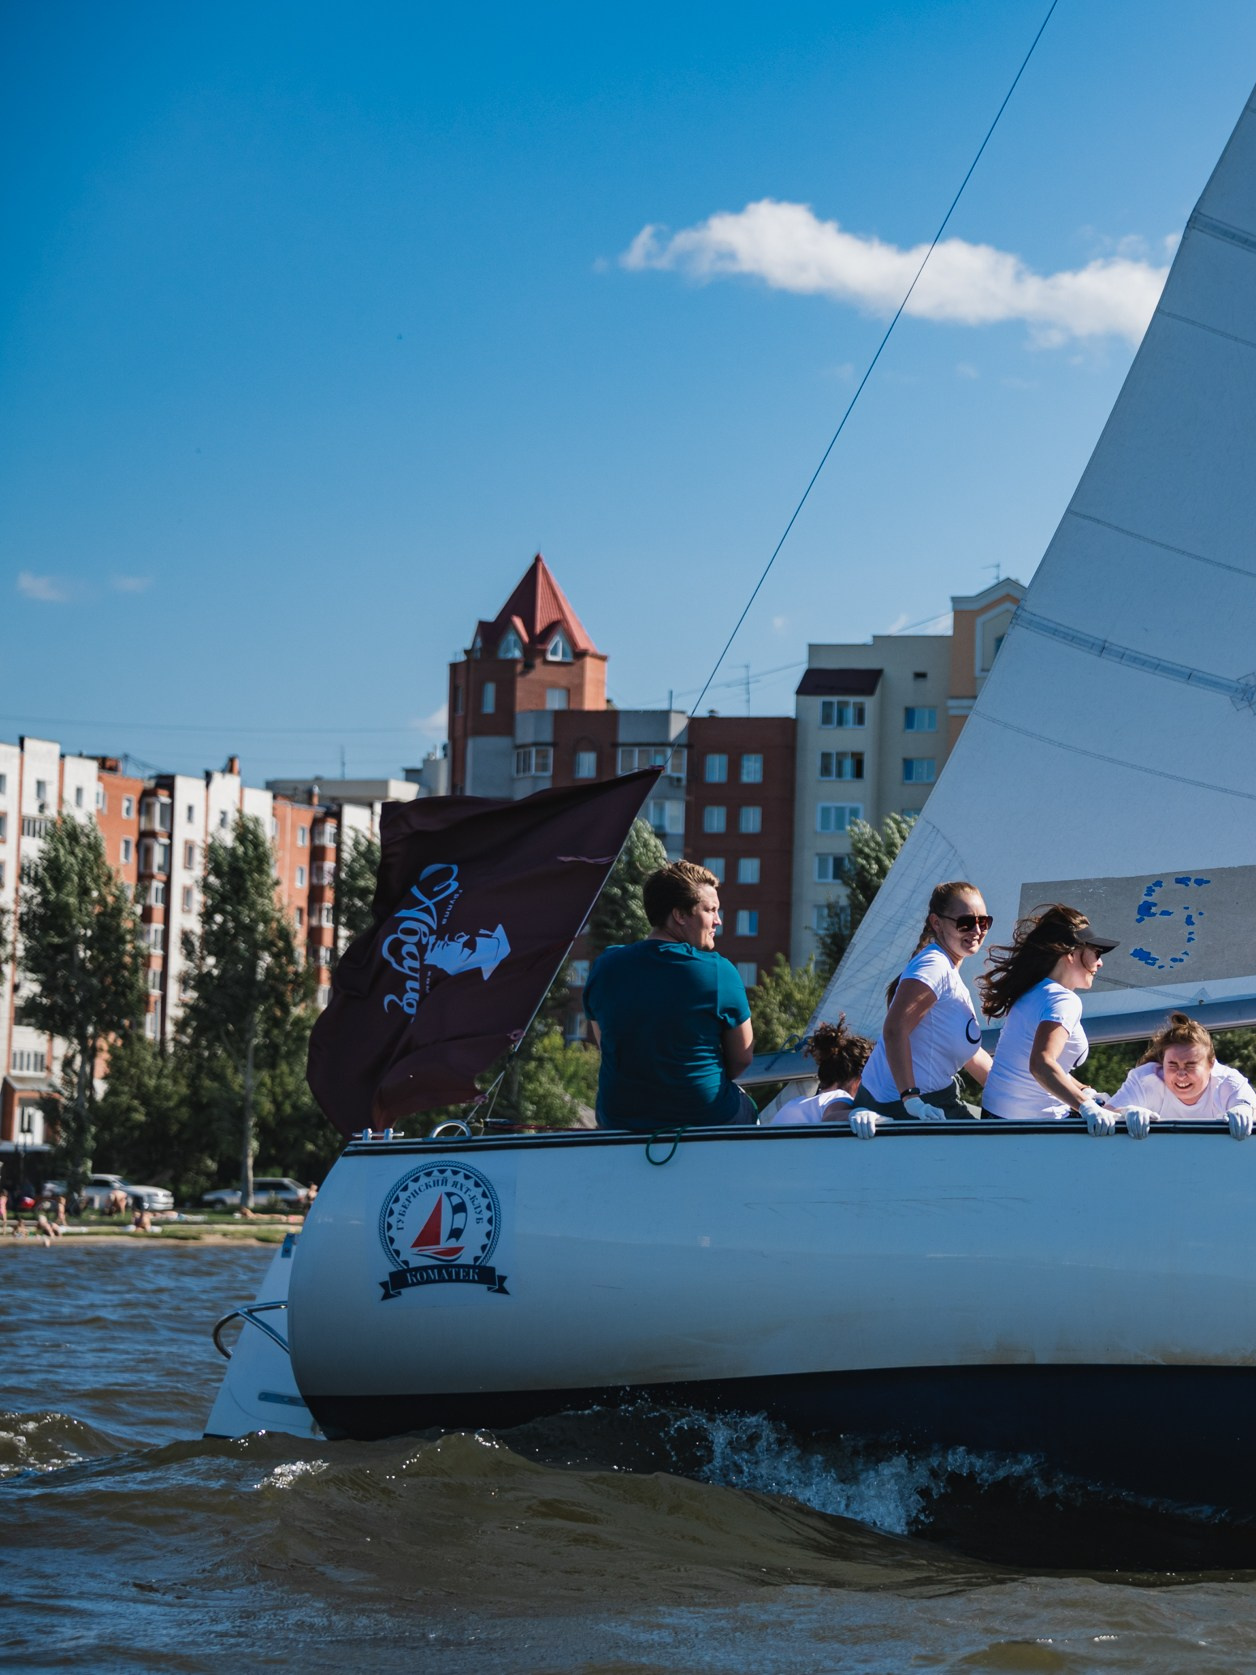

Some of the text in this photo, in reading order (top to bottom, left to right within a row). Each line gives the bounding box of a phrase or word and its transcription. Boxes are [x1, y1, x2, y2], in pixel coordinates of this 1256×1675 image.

[396, 1175, 484, 1231] ГУБЕРНСКИЙ ЯХТ-КЛУБ
[406, 1268, 479, 1285] КОМАТЕК
